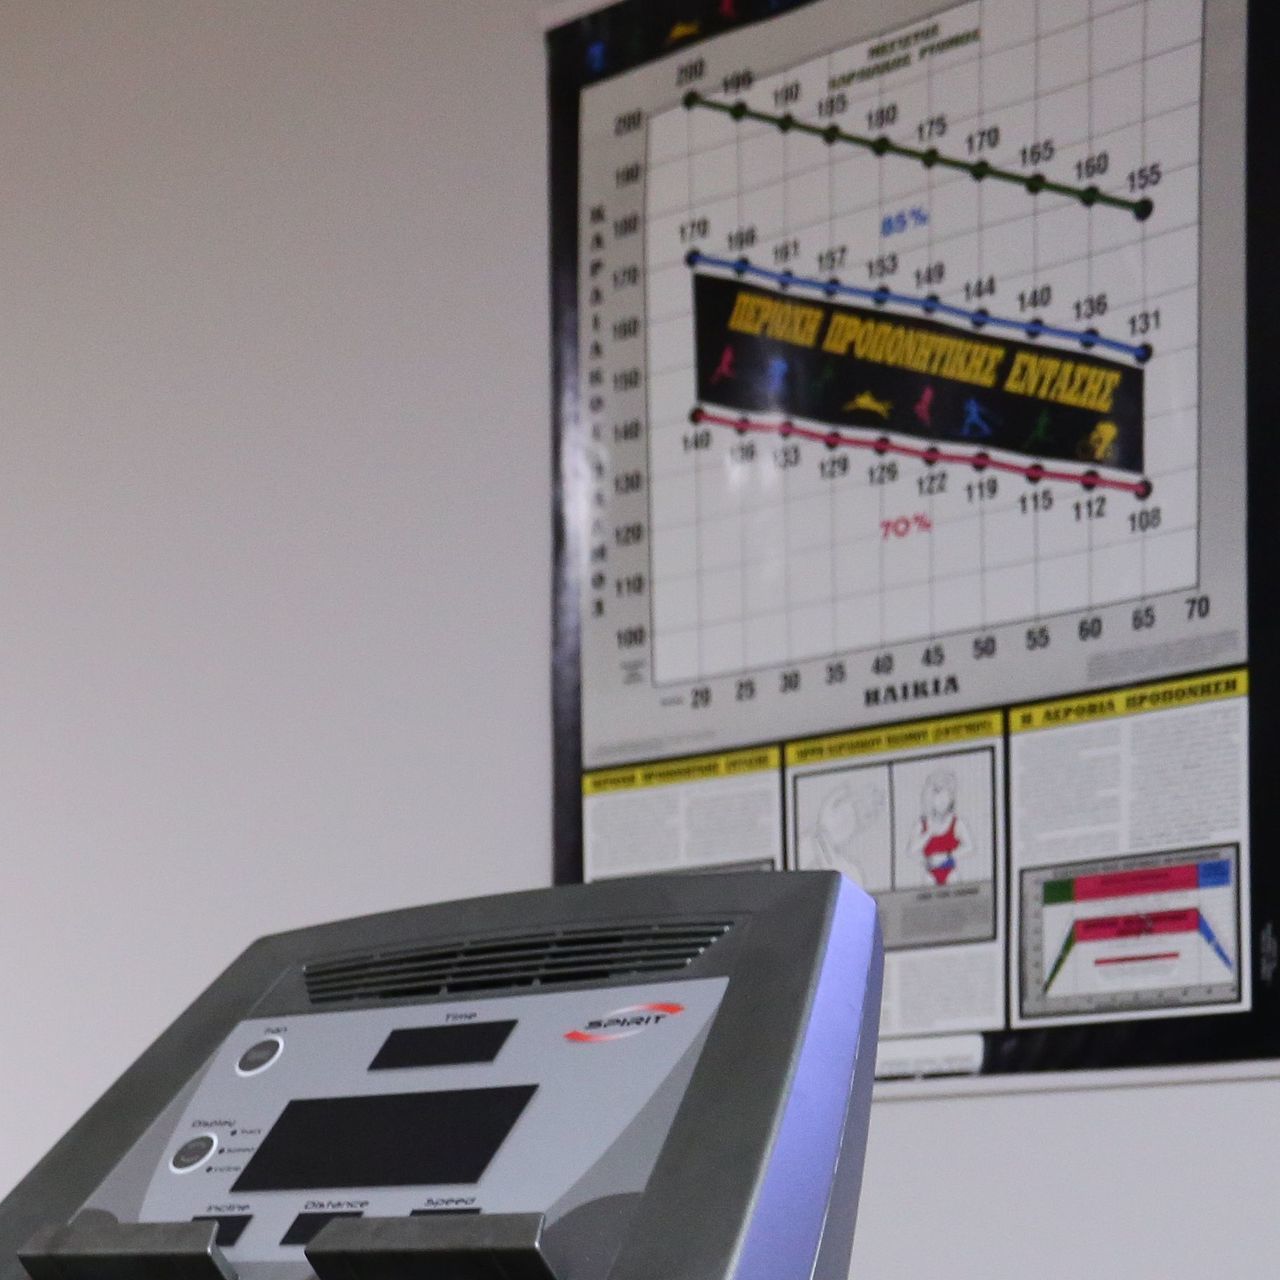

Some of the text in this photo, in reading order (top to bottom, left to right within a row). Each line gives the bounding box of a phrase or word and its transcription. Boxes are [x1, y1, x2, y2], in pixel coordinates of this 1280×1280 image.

[817, 92, 849, 118] 185
[866, 102, 898, 129] 180
[917, 113, 947, 142] 175
[965, 126, 1000, 154] 170
[1019, 139, 1055, 167] 165
[1074, 151, 1109, 180] 160
[1126, 163, 1162, 192] 155
[881, 206, 929, 238] 85%
[612, 265, 639, 289] 170
[679, 217, 710, 242] 170
[817, 245, 847, 271] 157
[866, 252, 899, 280] 153
[914, 261, 945, 288] 149
[963, 275, 996, 302] 144
[1016, 284, 1052, 312] 140
[1072, 293, 1108, 321] 136
[1128, 309, 1161, 336] 131
[728, 290, 1123, 414] ΠΕΡΙΟΧΗ ΠΡΟΠΟΝΗΤΙΚΗΣ ΕΝΤΑΣΗΣ
[613, 418, 641, 443] 140
[682, 430, 712, 453] 140
[819, 455, 849, 480] 129
[868, 462, 898, 487] 126
[916, 471, 947, 497] 122
[965, 477, 998, 504] 119
[1018, 489, 1054, 515] 115
[1072, 496, 1107, 522] 112
[1128, 507, 1161, 533] 108
[614, 523, 643, 547] 120
[880, 512, 932, 541] 70%
[615, 572, 644, 597] 110
[616, 625, 646, 650] 100
[690, 687, 712, 709] 20
[735, 679, 756, 702] 25
[780, 670, 801, 693] 30
[825, 661, 847, 685] 35
[871, 653, 894, 676] 40
[921, 643, 945, 668] 45
[972, 636, 997, 660] 50
[1025, 625, 1051, 651] 55
[1077, 617, 1103, 642] 60
[1131, 606, 1156, 631] 65
[1185, 595, 1211, 620] 70
[864, 675, 960, 708] ΗΛΙΚΙΑ
[585, 1015, 665, 1030] SPIRIT
[304, 1199, 370, 1210] Distance
[424, 1196, 477, 1207] Speed
